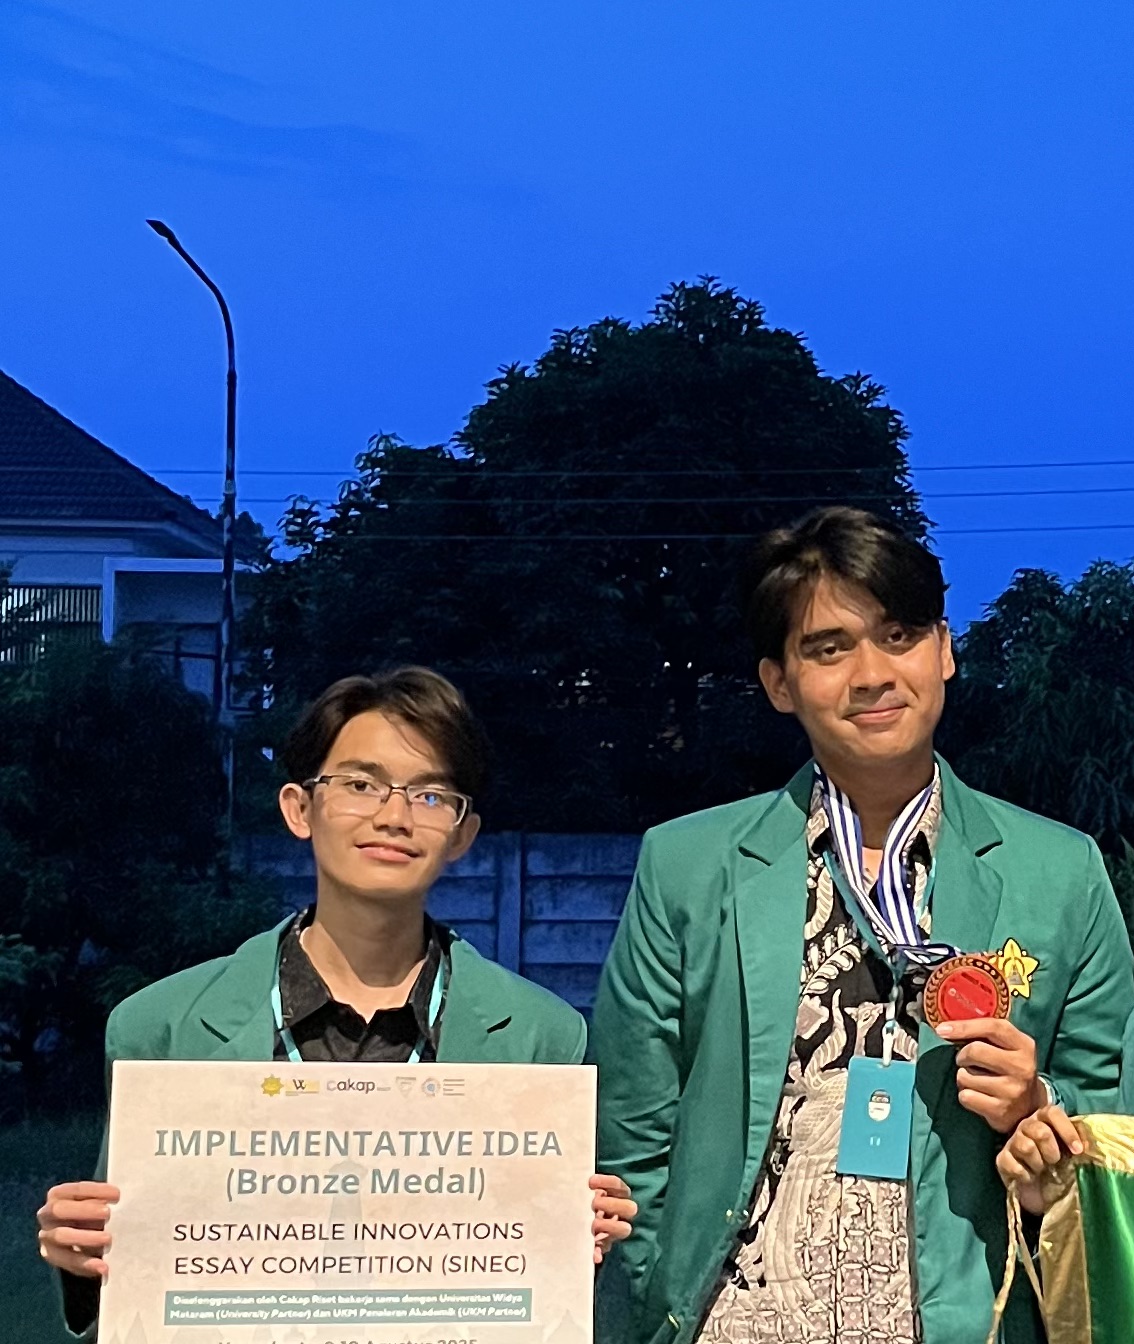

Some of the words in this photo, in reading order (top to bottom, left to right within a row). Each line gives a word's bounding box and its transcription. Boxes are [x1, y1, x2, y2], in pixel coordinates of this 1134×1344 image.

[154, 1129, 473, 1157] IMPLEMENTATIVE
[482, 1130, 563, 1157] IDEA
[226, 1167, 360, 1203] (Bronze
[370, 1166, 486, 1202] Medal)
[172, 1223, 346, 1242] SUSTAINABLE
[353, 1222, 525, 1241] INNOVATIONS
[174, 1256, 255, 1275] ESSAY
[261, 1255, 433, 1275] COMPETITION
[441, 1254, 527, 1276] (SINEC)
[278, 1294, 311, 1306] Cakap
[439, 1293, 492, 1303] Universitas
[492, 1292, 523, 1304] Widya
[215, 1309, 270, 1321] (University
[312, 1308, 332, 1318] dan
[332, 1308, 358, 1318] UKM
